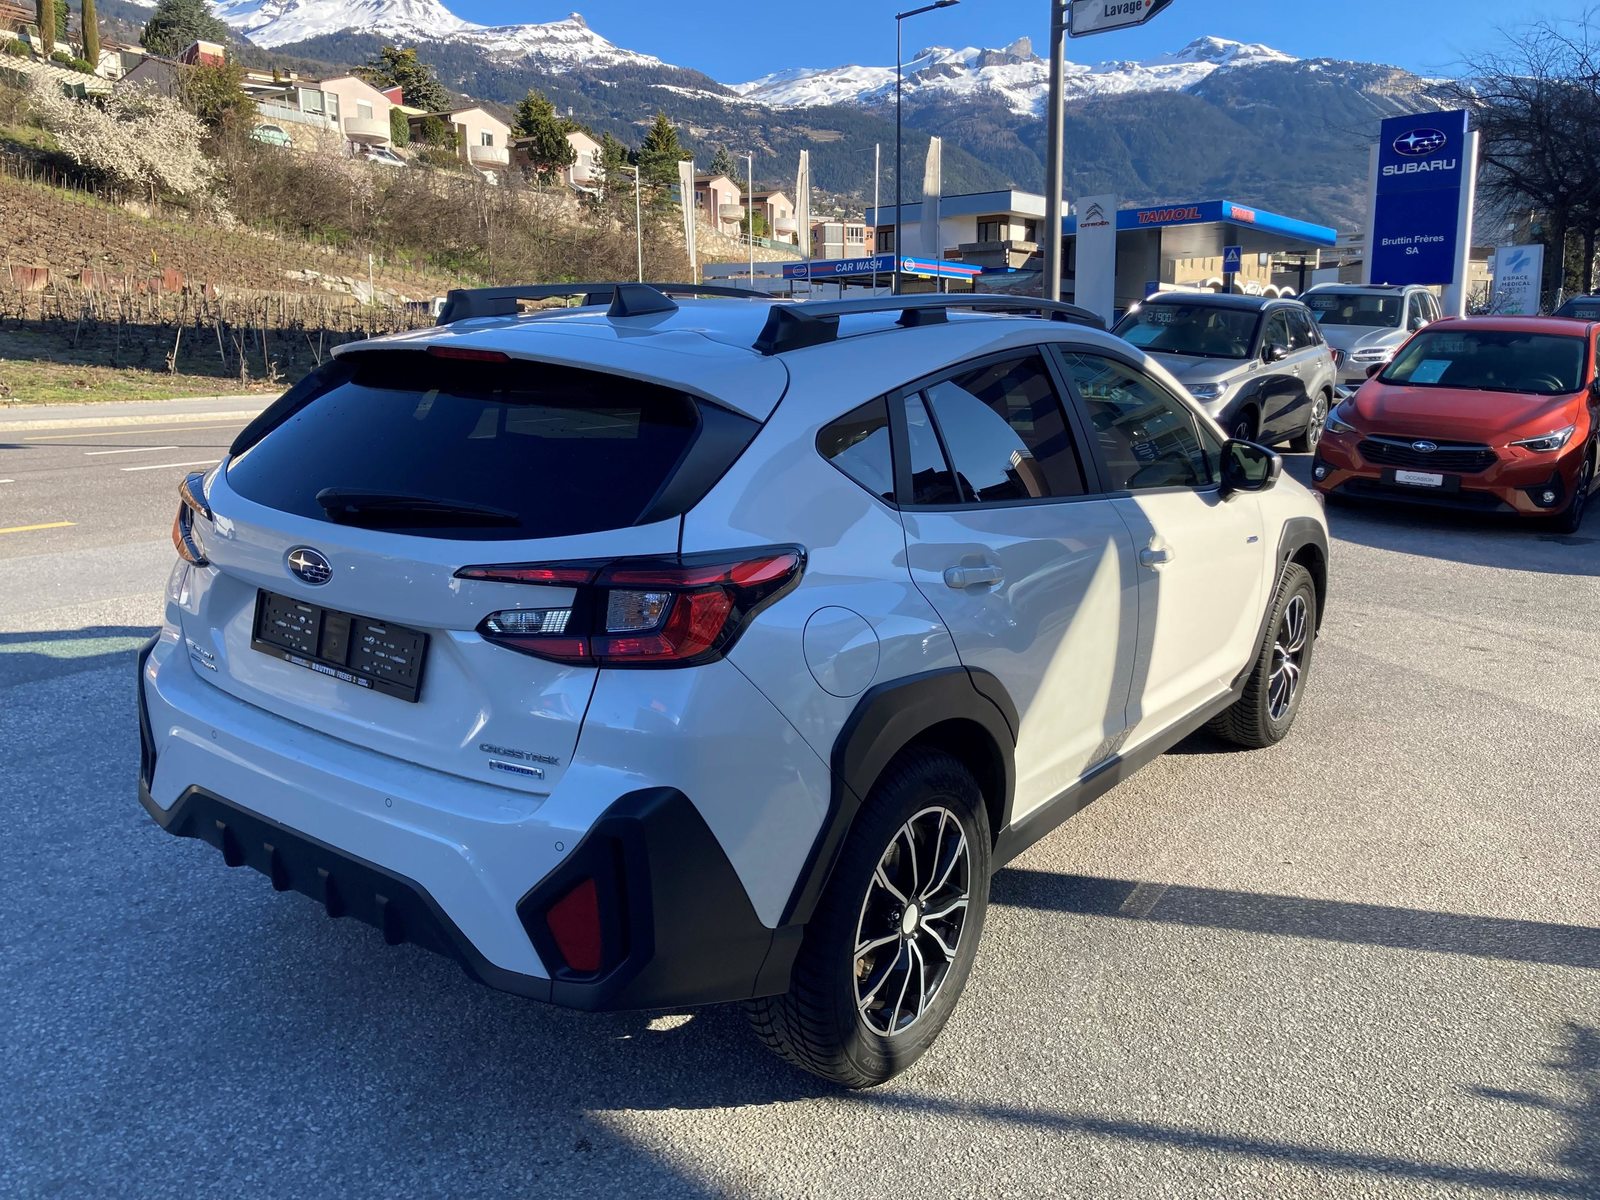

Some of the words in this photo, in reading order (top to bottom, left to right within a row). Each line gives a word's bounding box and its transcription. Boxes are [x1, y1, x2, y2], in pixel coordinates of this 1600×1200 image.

[1104, 0, 1142, 17] Lavage
[1382, 158, 1456, 177] SUBARU
[1137, 206, 1202, 224] TAMOIL
[1381, 236, 1412, 246] Bruttin
[1414, 234, 1445, 244] Frères
[1405, 246, 1419, 255] SA
[835, 262, 854, 273] CAR
[856, 260, 883, 271] WASH
[1404, 474, 1435, 483] OCCASION
